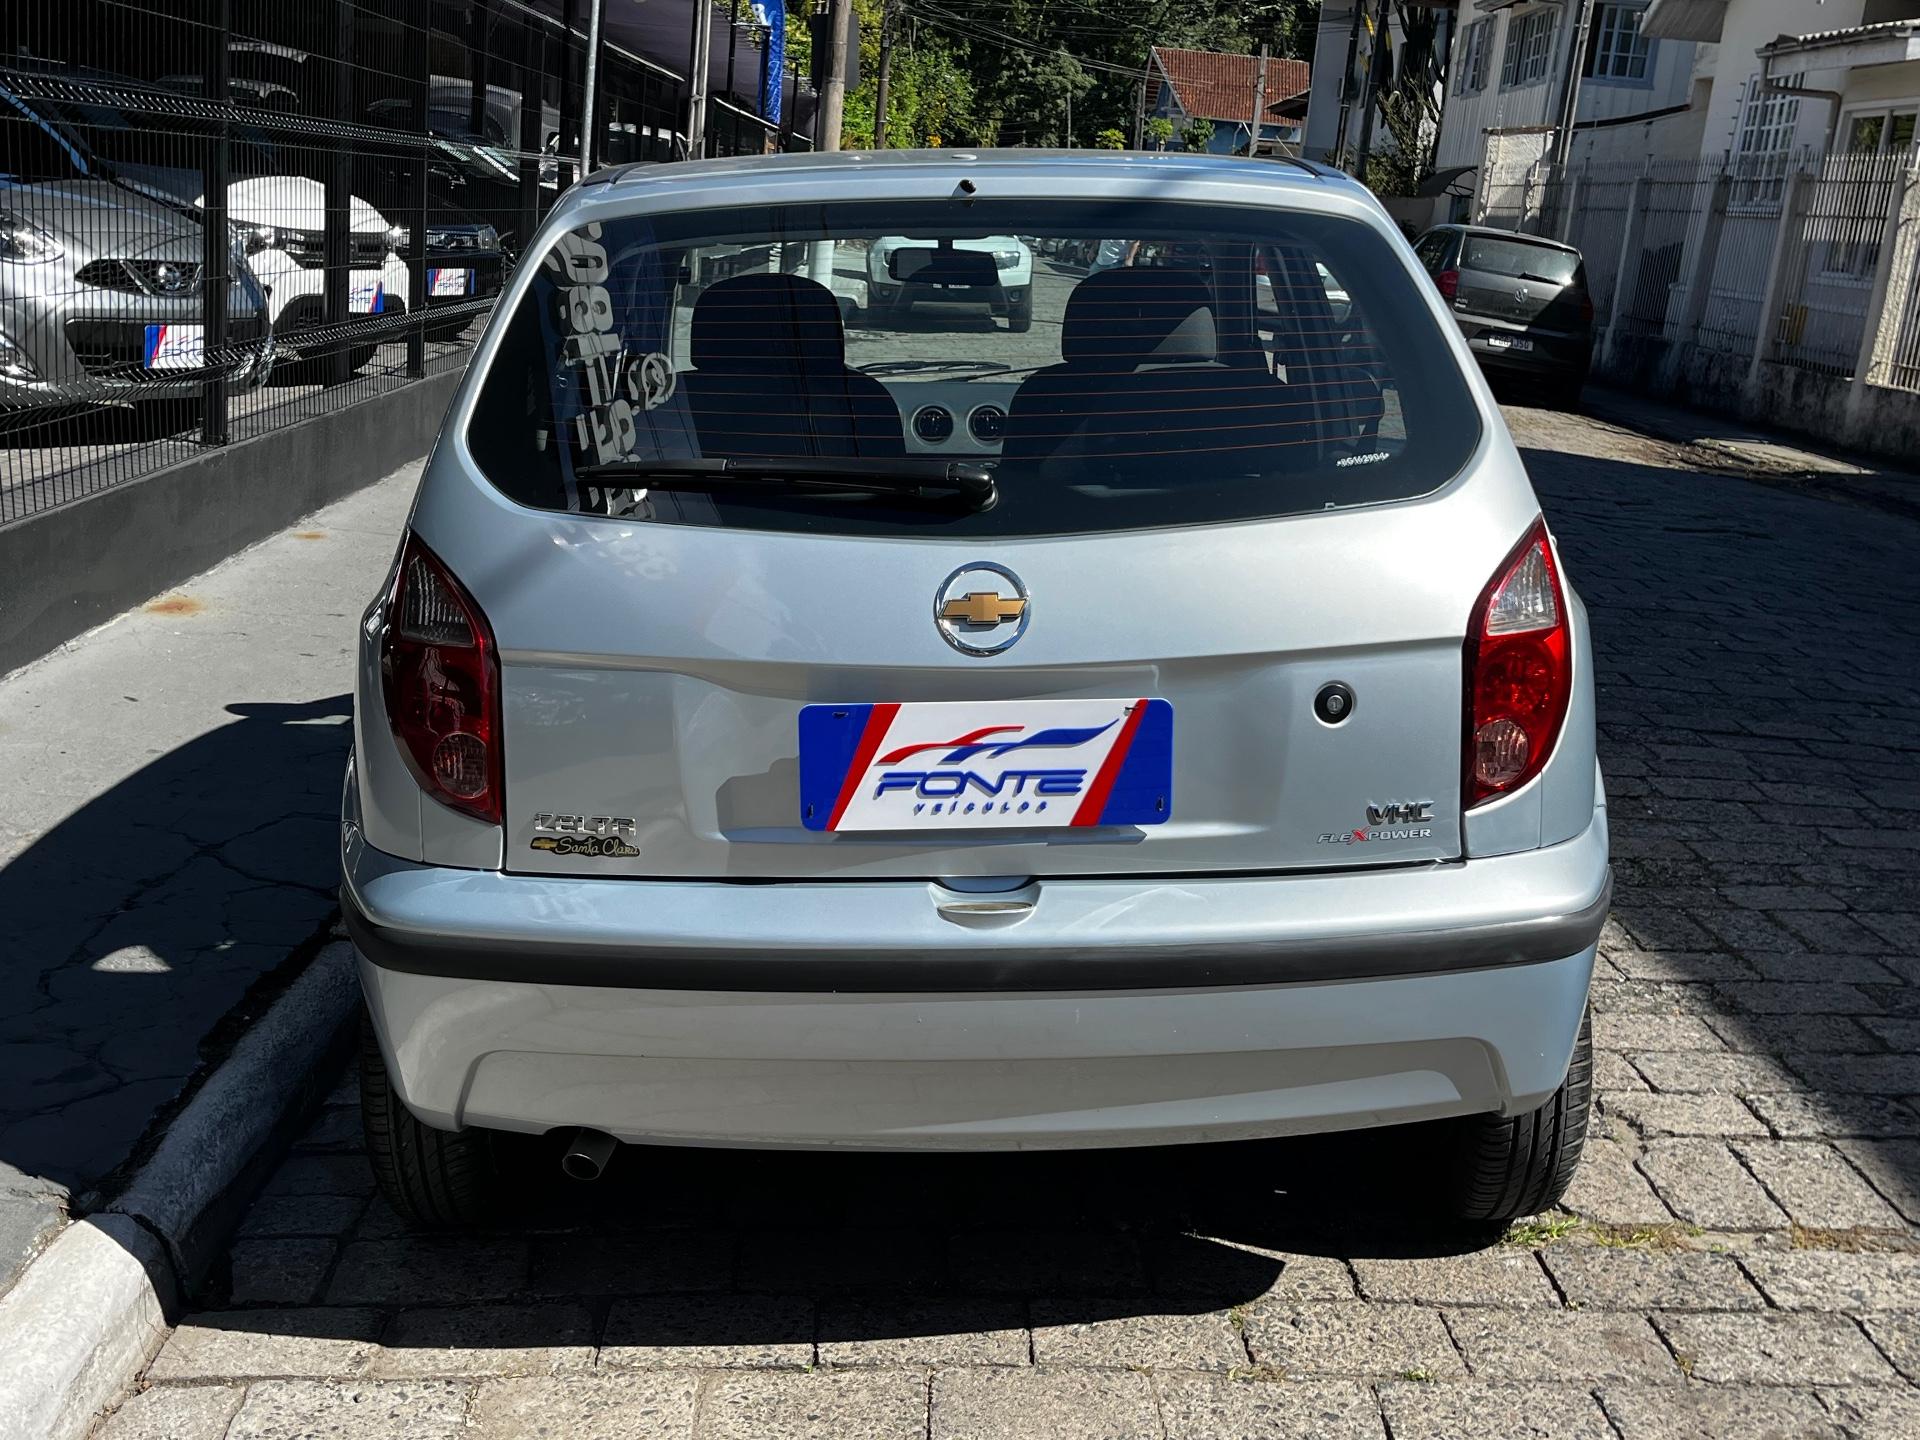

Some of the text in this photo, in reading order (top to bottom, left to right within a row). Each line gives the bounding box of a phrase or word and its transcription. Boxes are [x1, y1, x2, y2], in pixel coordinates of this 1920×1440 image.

[873, 768, 1087, 798] FONTE
[534, 813, 636, 836] CELTA
[1366, 800, 1434, 825] VHC
[555, 838, 600, 856] Santa
